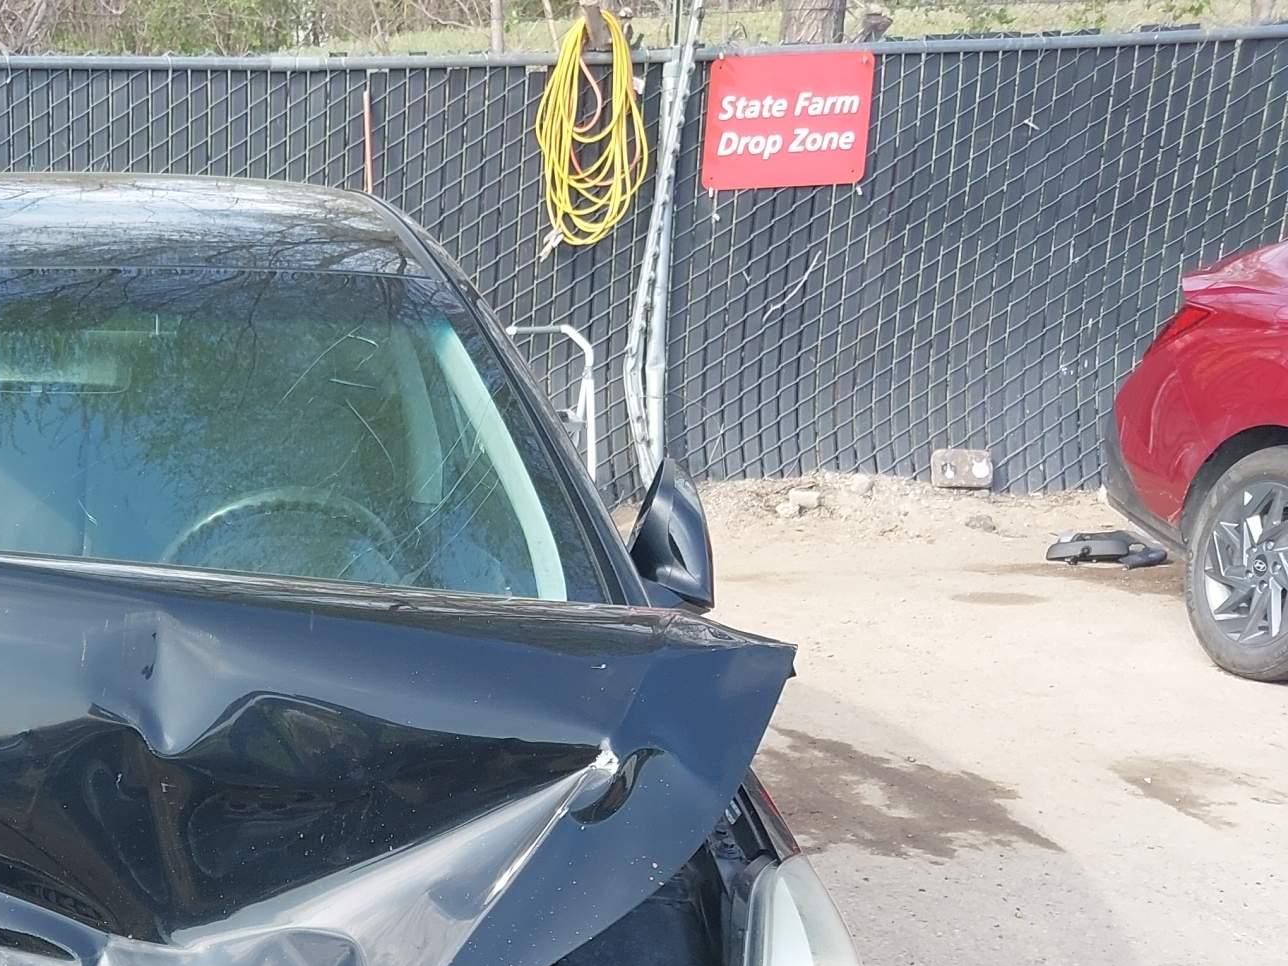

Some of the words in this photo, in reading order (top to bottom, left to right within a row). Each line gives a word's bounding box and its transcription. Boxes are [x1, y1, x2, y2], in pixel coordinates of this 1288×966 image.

[718, 95, 788, 121] State
[793, 92, 860, 117] Farm
[717, 131, 783, 160] Drop
[788, 128, 855, 153] Zone
